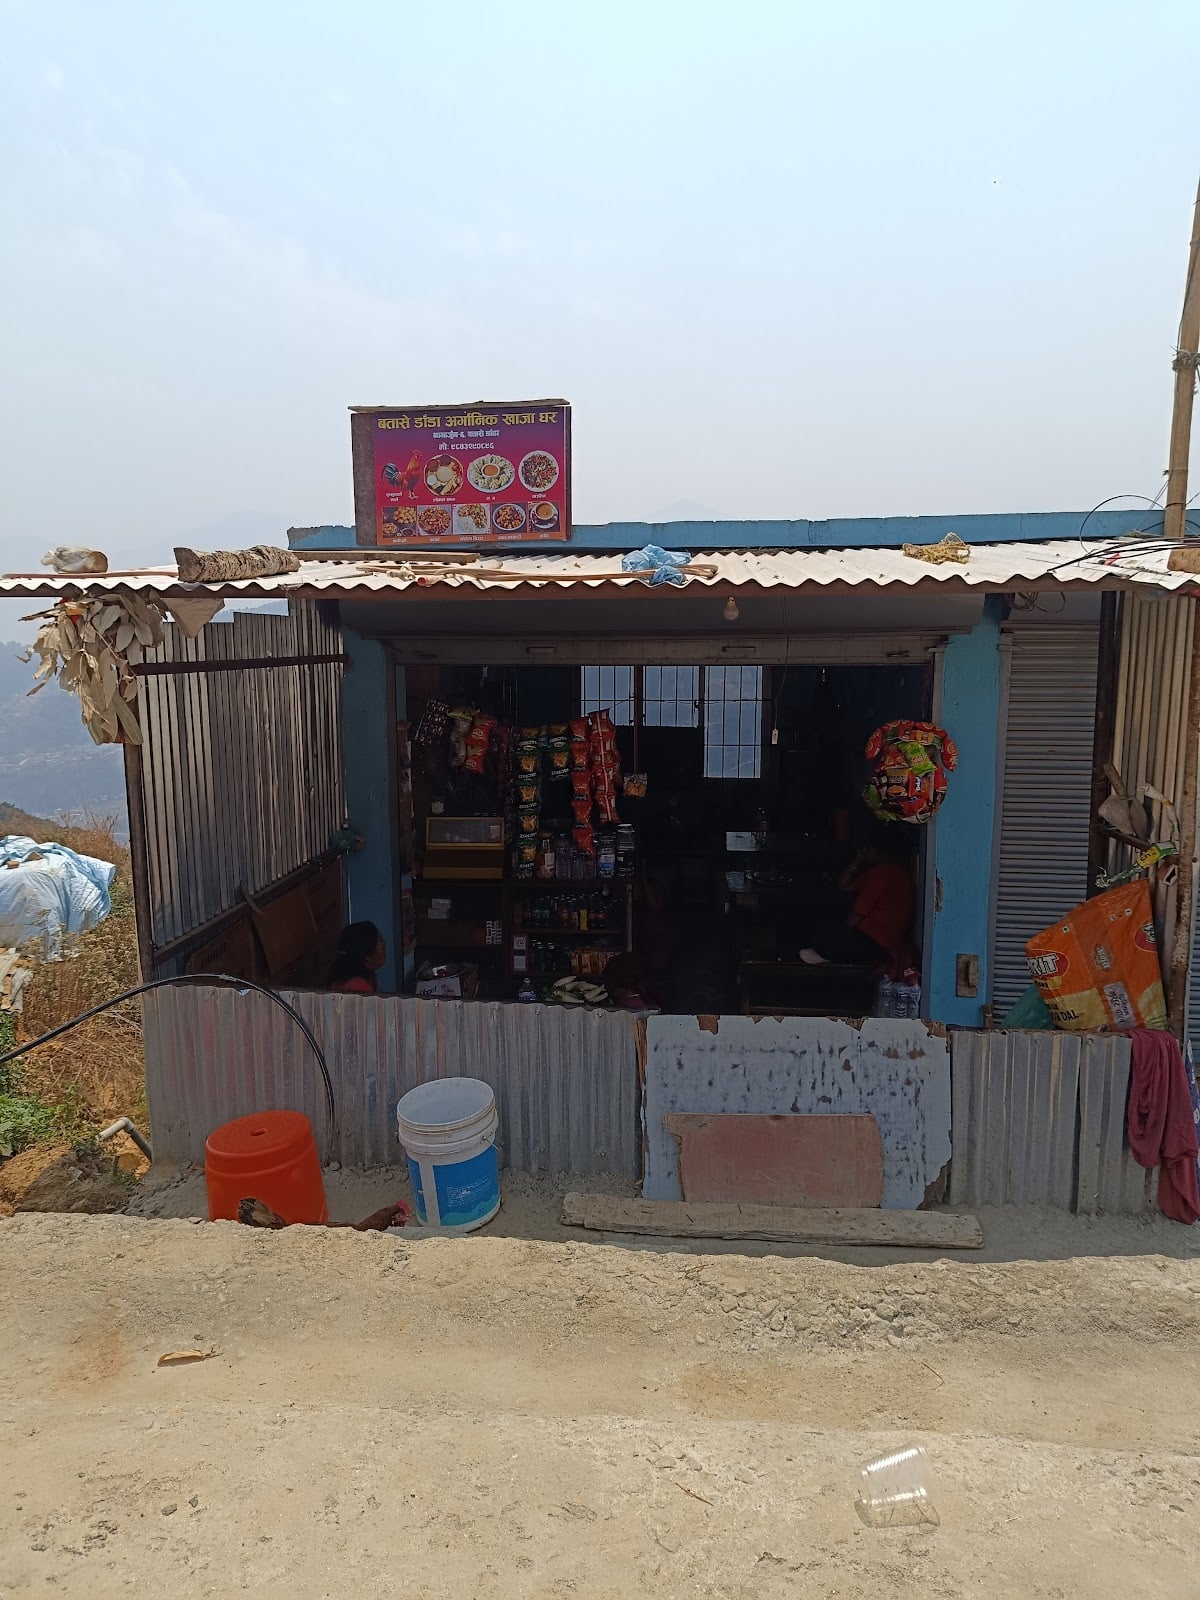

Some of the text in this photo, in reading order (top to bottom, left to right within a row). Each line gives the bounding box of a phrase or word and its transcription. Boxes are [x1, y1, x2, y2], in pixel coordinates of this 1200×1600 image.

[377, 414, 411, 430] बतासे
[502, 412, 536, 425] खाजा
[539, 411, 558, 424] घर
[1027, 953, 1058, 978] RIT
[1062, 1009, 1079, 1022] DAL
